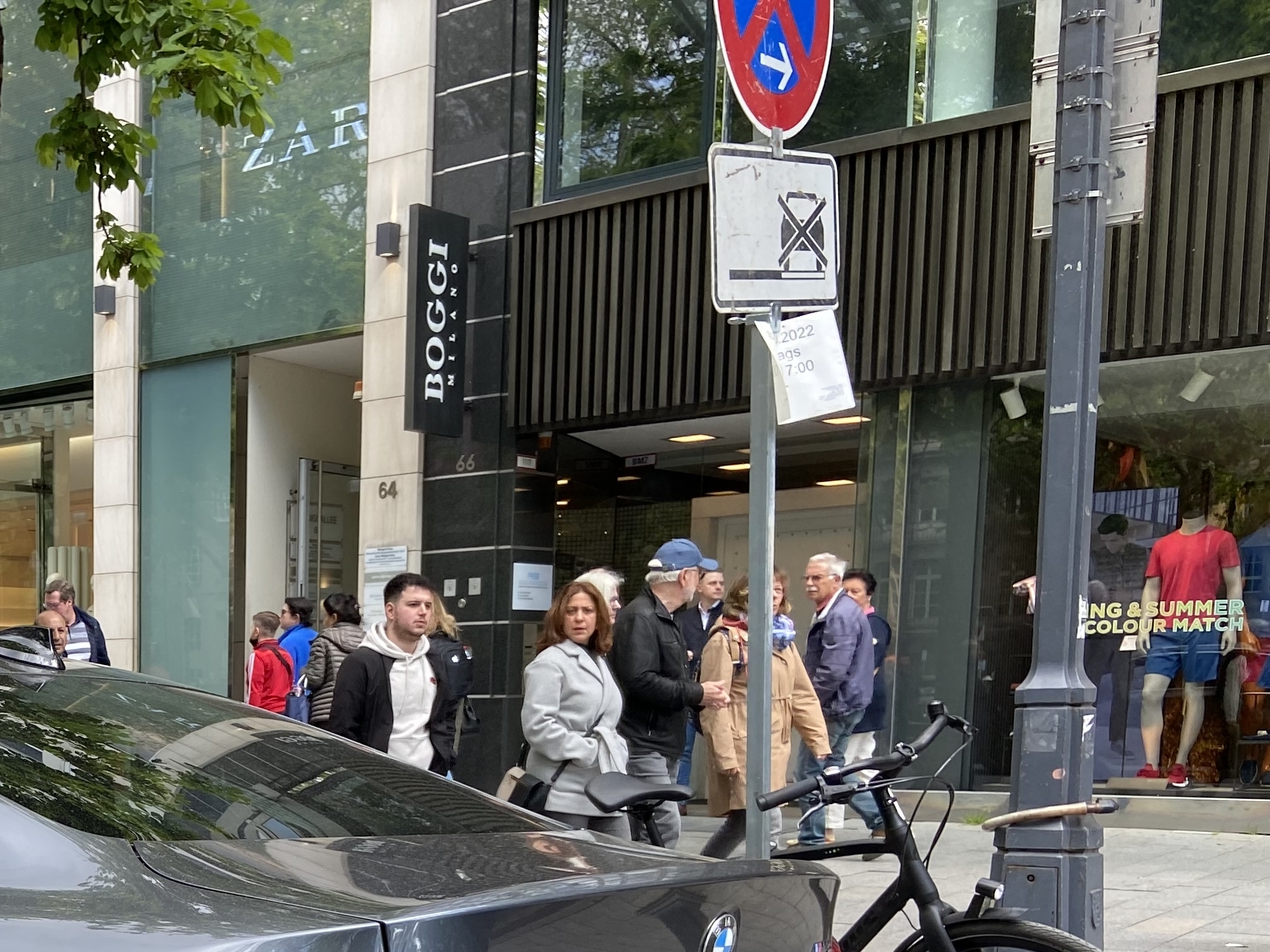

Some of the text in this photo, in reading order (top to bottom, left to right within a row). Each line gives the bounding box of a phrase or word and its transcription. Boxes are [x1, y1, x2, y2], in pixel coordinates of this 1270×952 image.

[424, 238, 449, 403] BOGGI
[447, 263, 459, 386] MILANO
[455, 454, 476, 472] 66
[378, 480, 398, 499] 64
[1127, 602, 1142, 617] &
[1145, 599, 1244, 617] SUMMER
[1085, 617, 1244, 635] COLOUR MATCH
